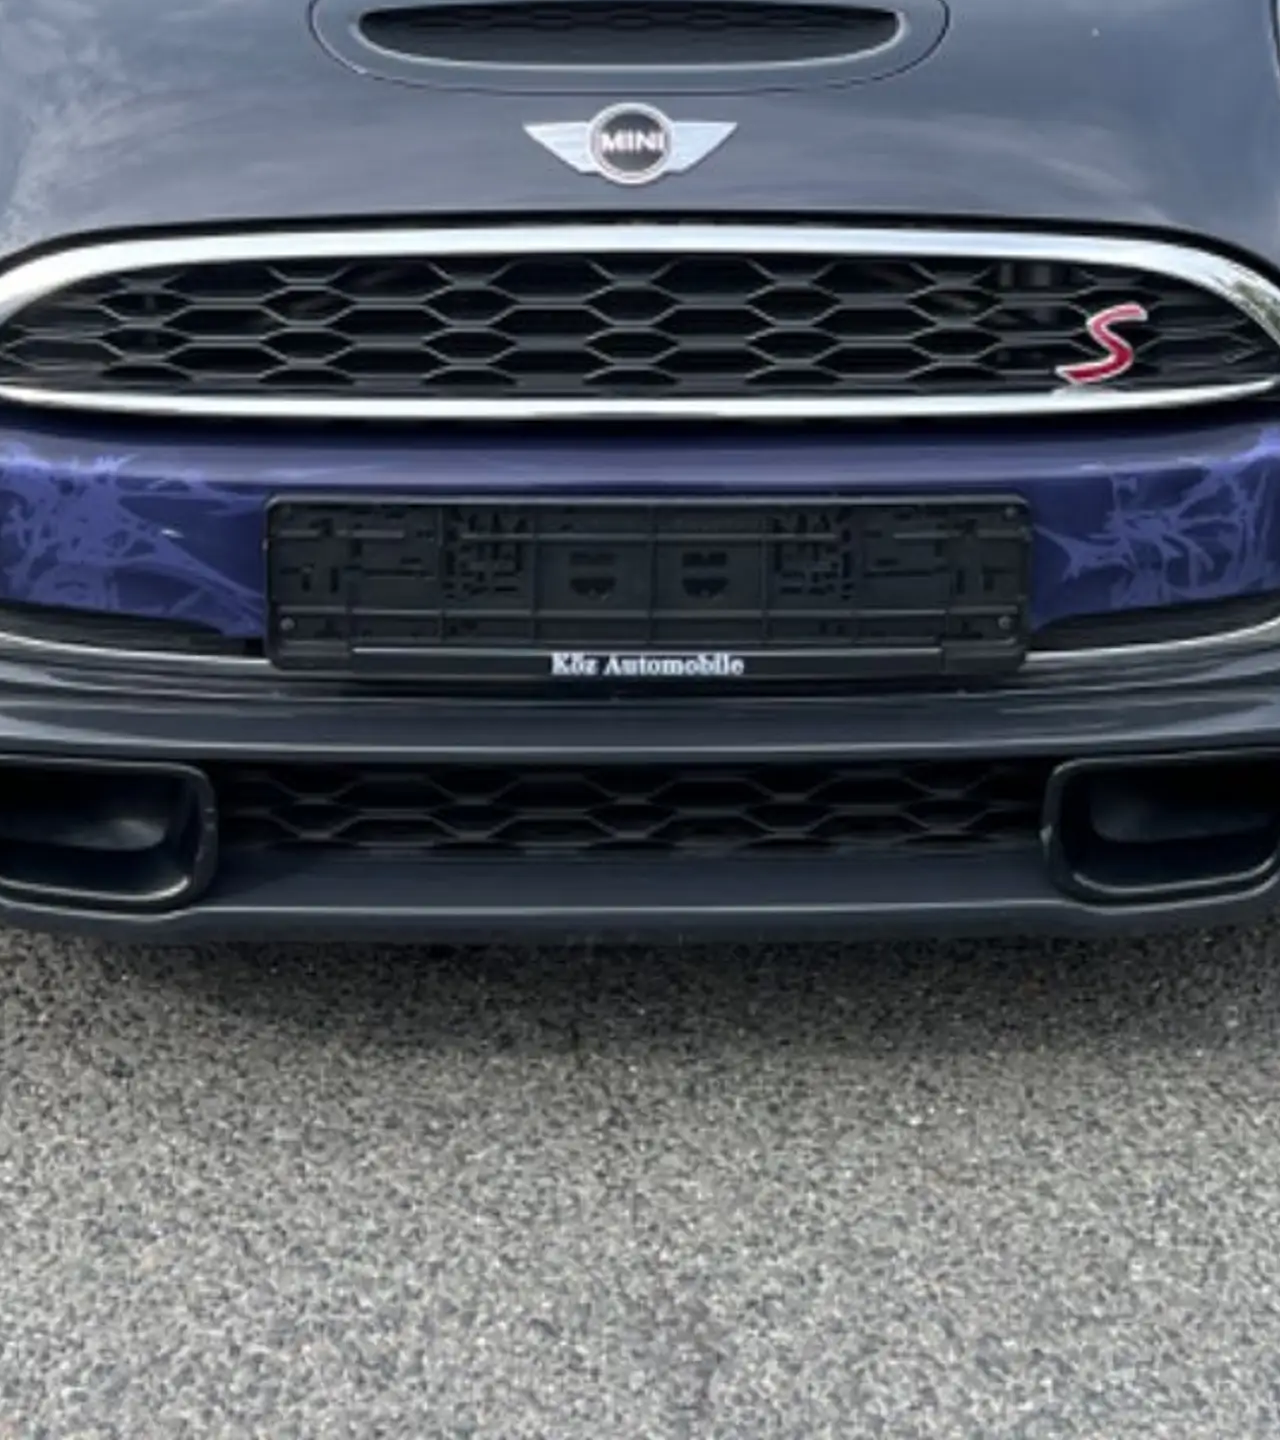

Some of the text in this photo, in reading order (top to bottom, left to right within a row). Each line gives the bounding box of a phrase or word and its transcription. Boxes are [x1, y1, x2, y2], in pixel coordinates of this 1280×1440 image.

[600, 127, 667, 154] MINI
[1054, 301, 1148, 385] S
[551, 651, 745, 676] Köz Automobile
